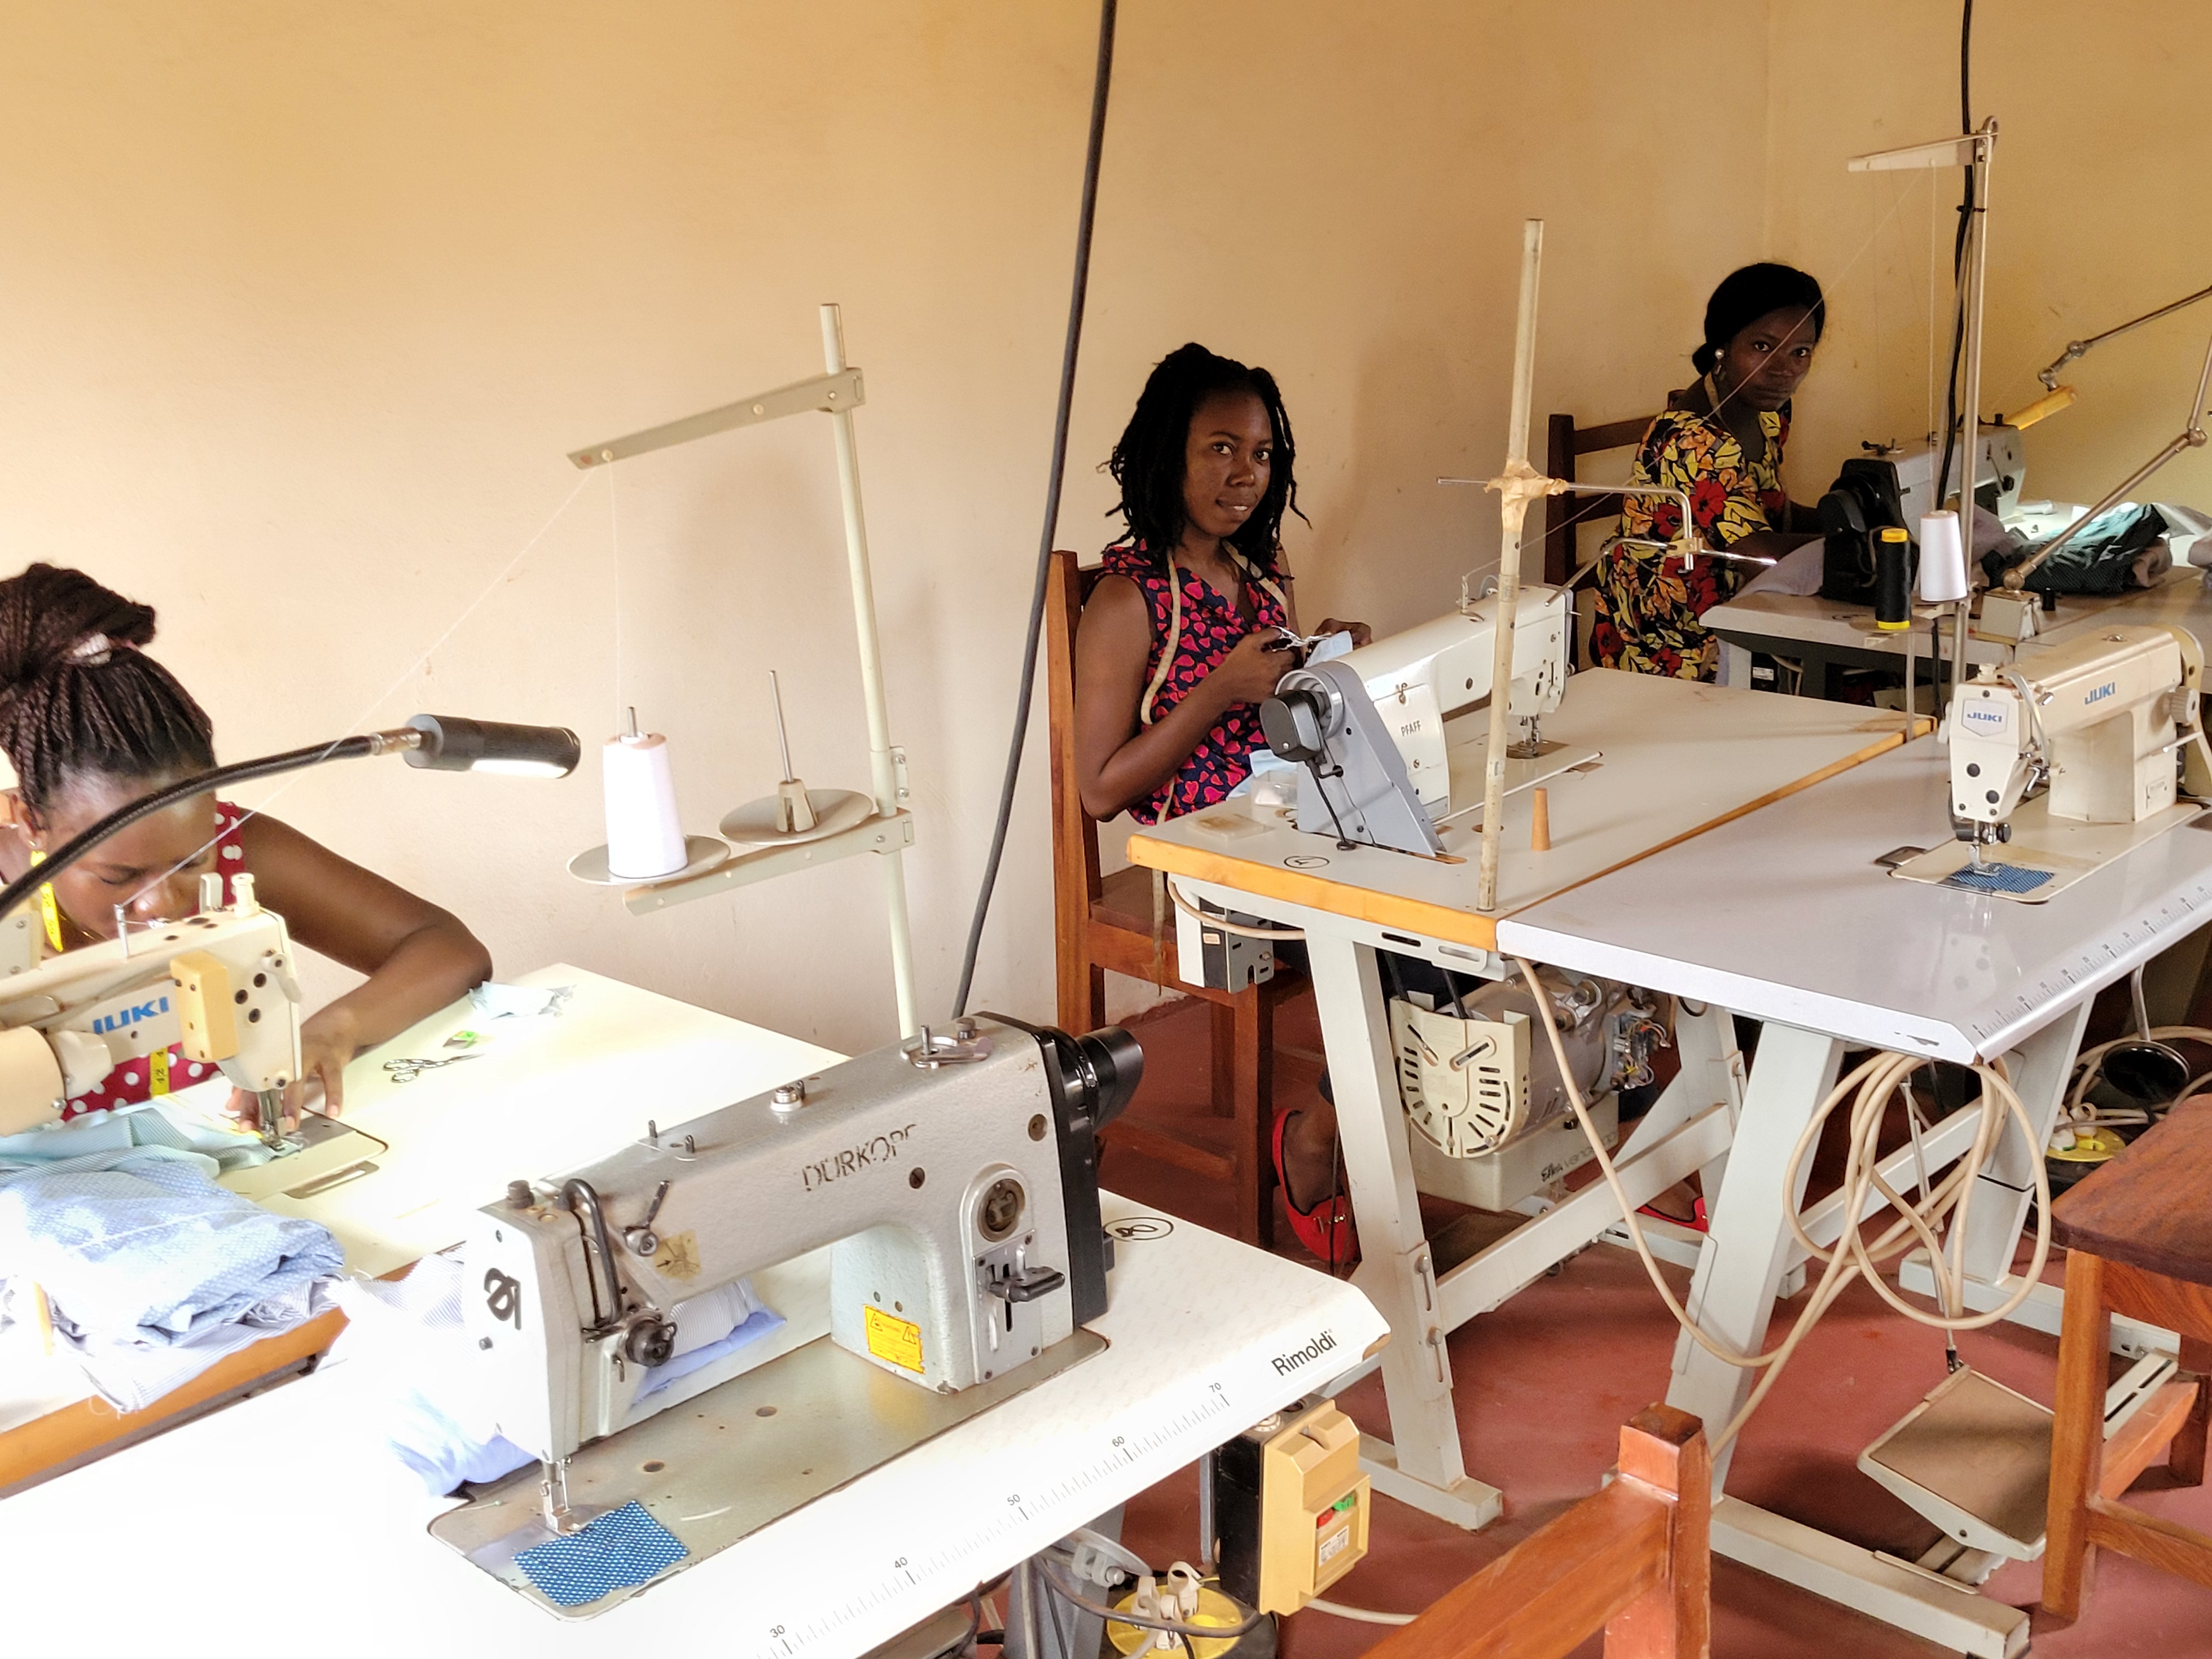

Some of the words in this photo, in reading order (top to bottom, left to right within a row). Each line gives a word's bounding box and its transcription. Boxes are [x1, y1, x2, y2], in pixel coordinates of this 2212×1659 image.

[2084, 681, 2115, 705] JUKI
[1401, 720, 1421, 737] PFAFF
[1967, 712, 2002, 723] JUKI
[1271, 1330, 1338, 1376] Rimoldi
[770, 1624, 785, 1638] 30
[895, 1557, 908, 1568] 40
[1007, 1494, 1020, 1506] 50
[1111, 1436, 1125, 1447] 60
[1209, 1383, 1222, 1393] 70
